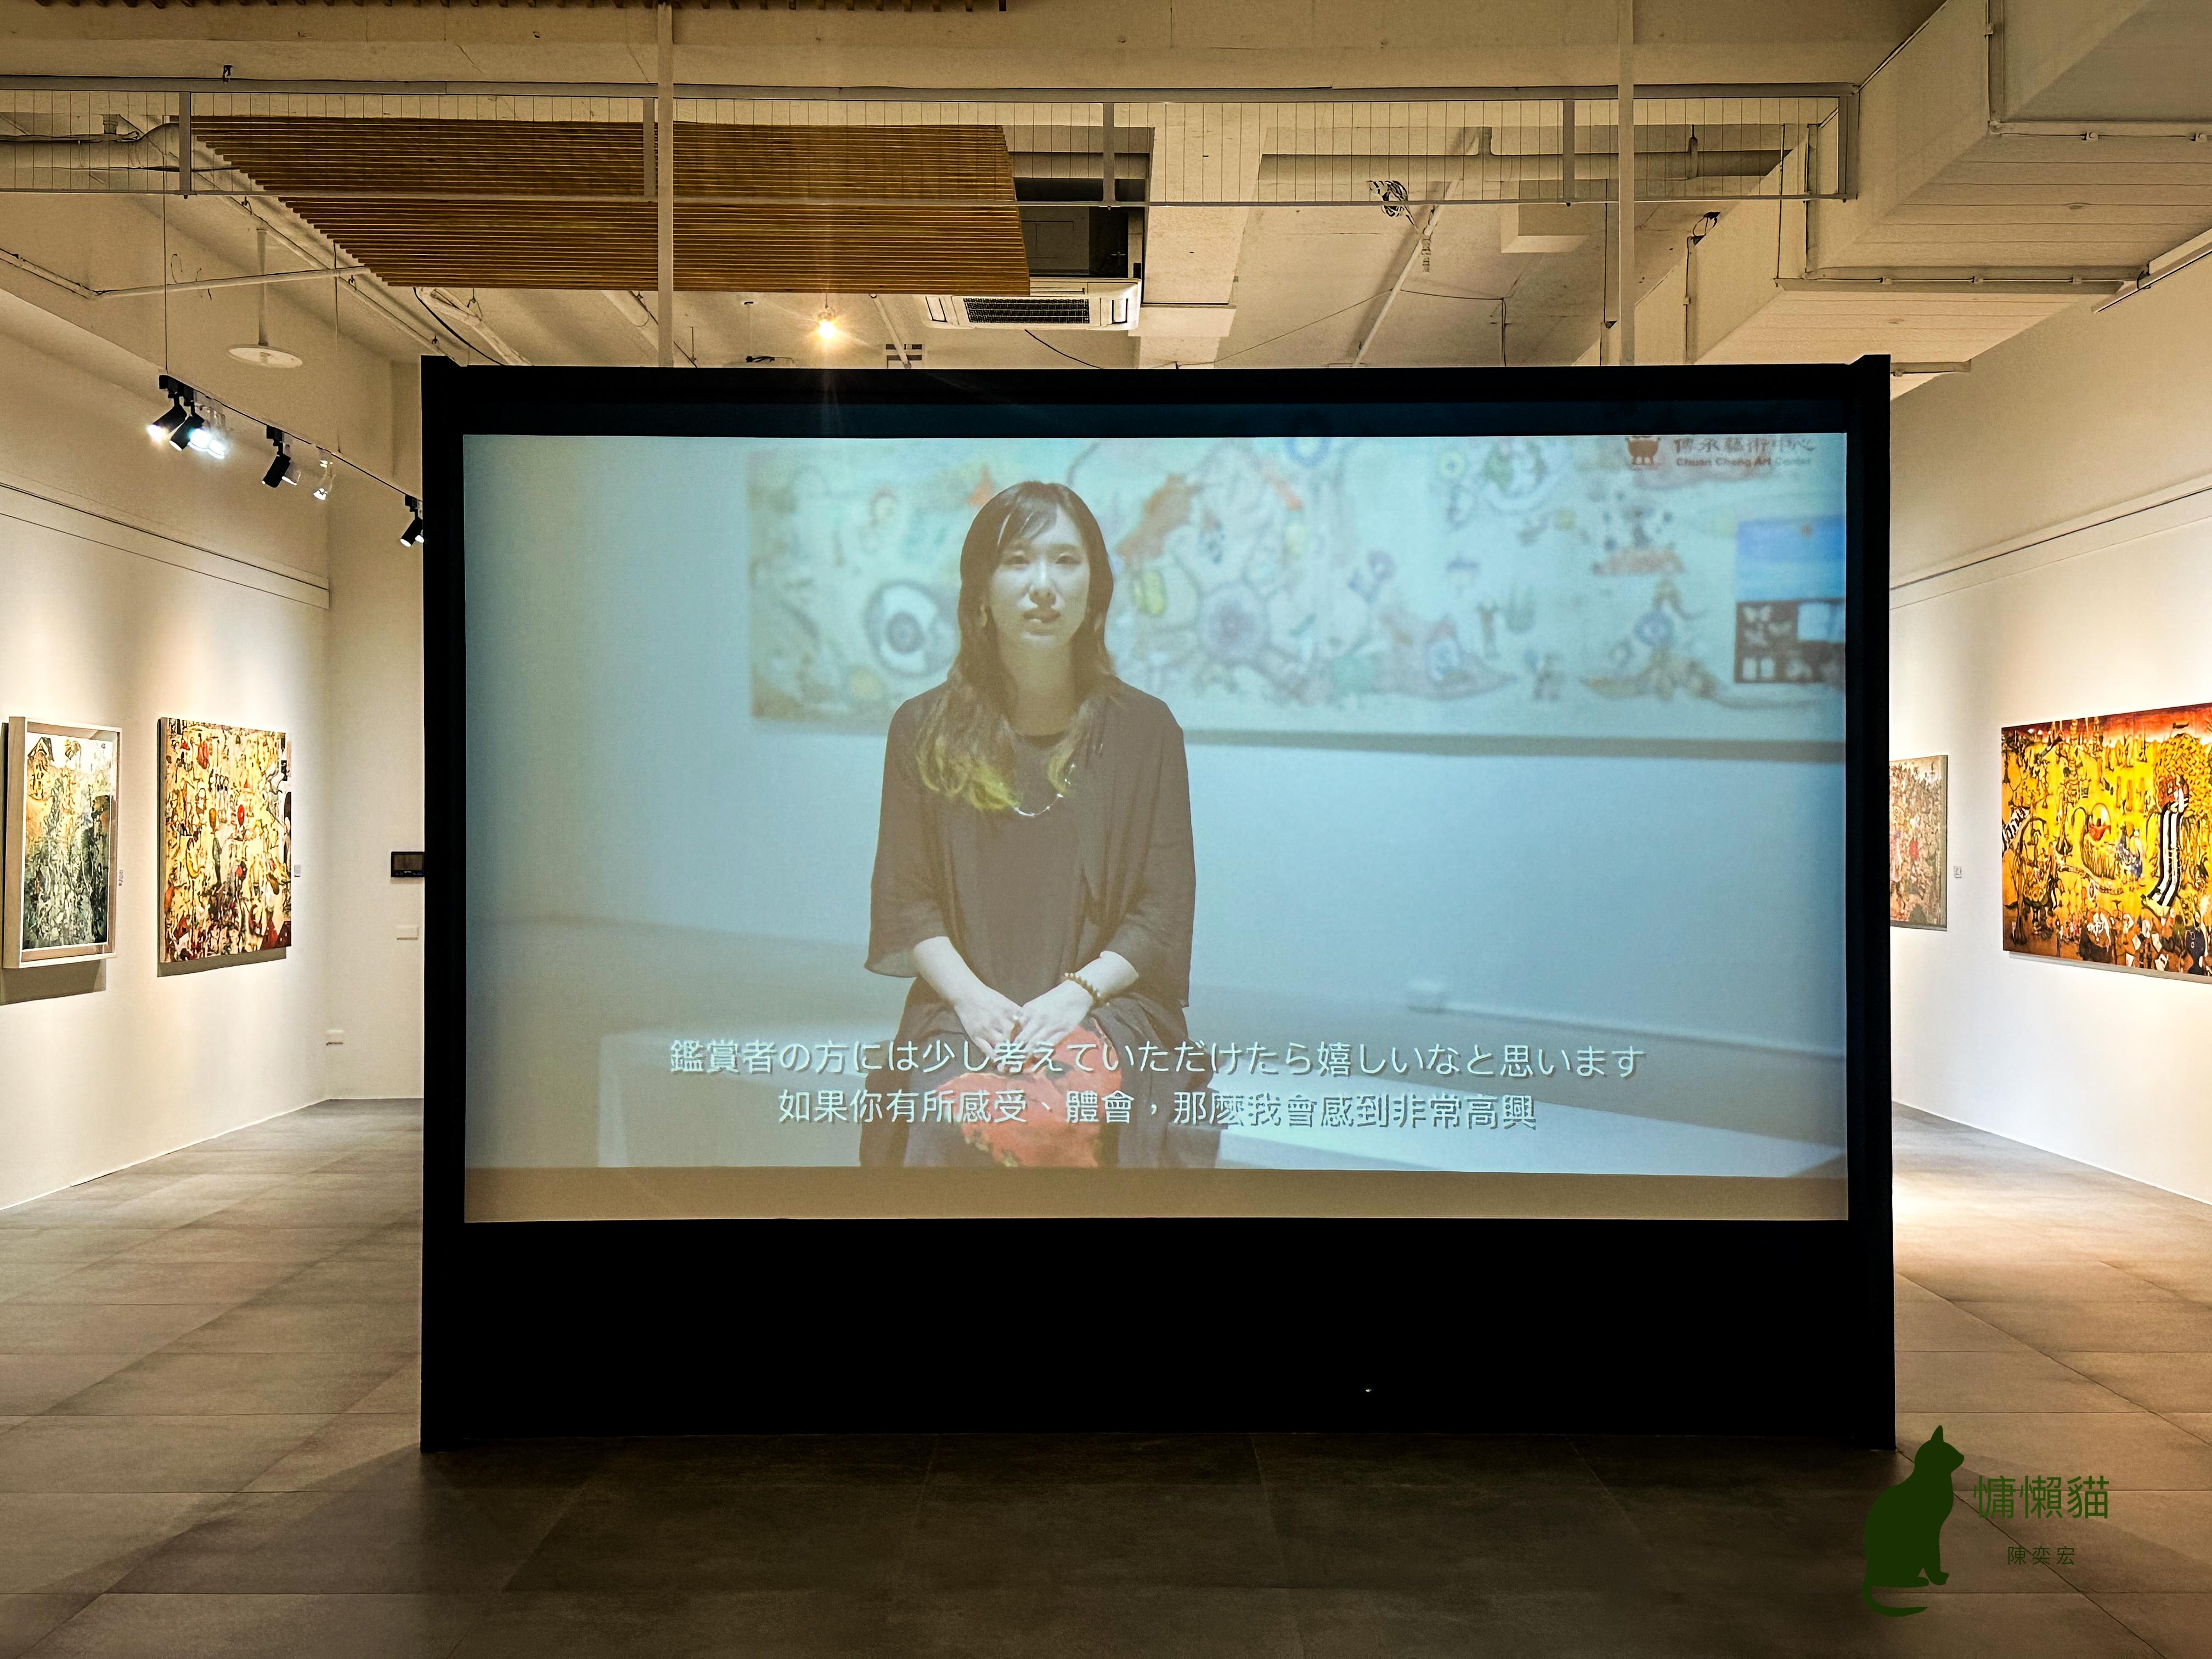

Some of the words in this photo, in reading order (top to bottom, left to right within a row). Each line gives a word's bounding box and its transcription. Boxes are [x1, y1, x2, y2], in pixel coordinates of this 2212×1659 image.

[1754, 457, 1771, 466] Art
[670, 1039, 1645, 1078] 鑑賞者の方には少し考えていただけたら嬉しいなと思います
[778, 1088, 1537, 1130] 如果你有所感受、體會，那麼我會感到非常高興
